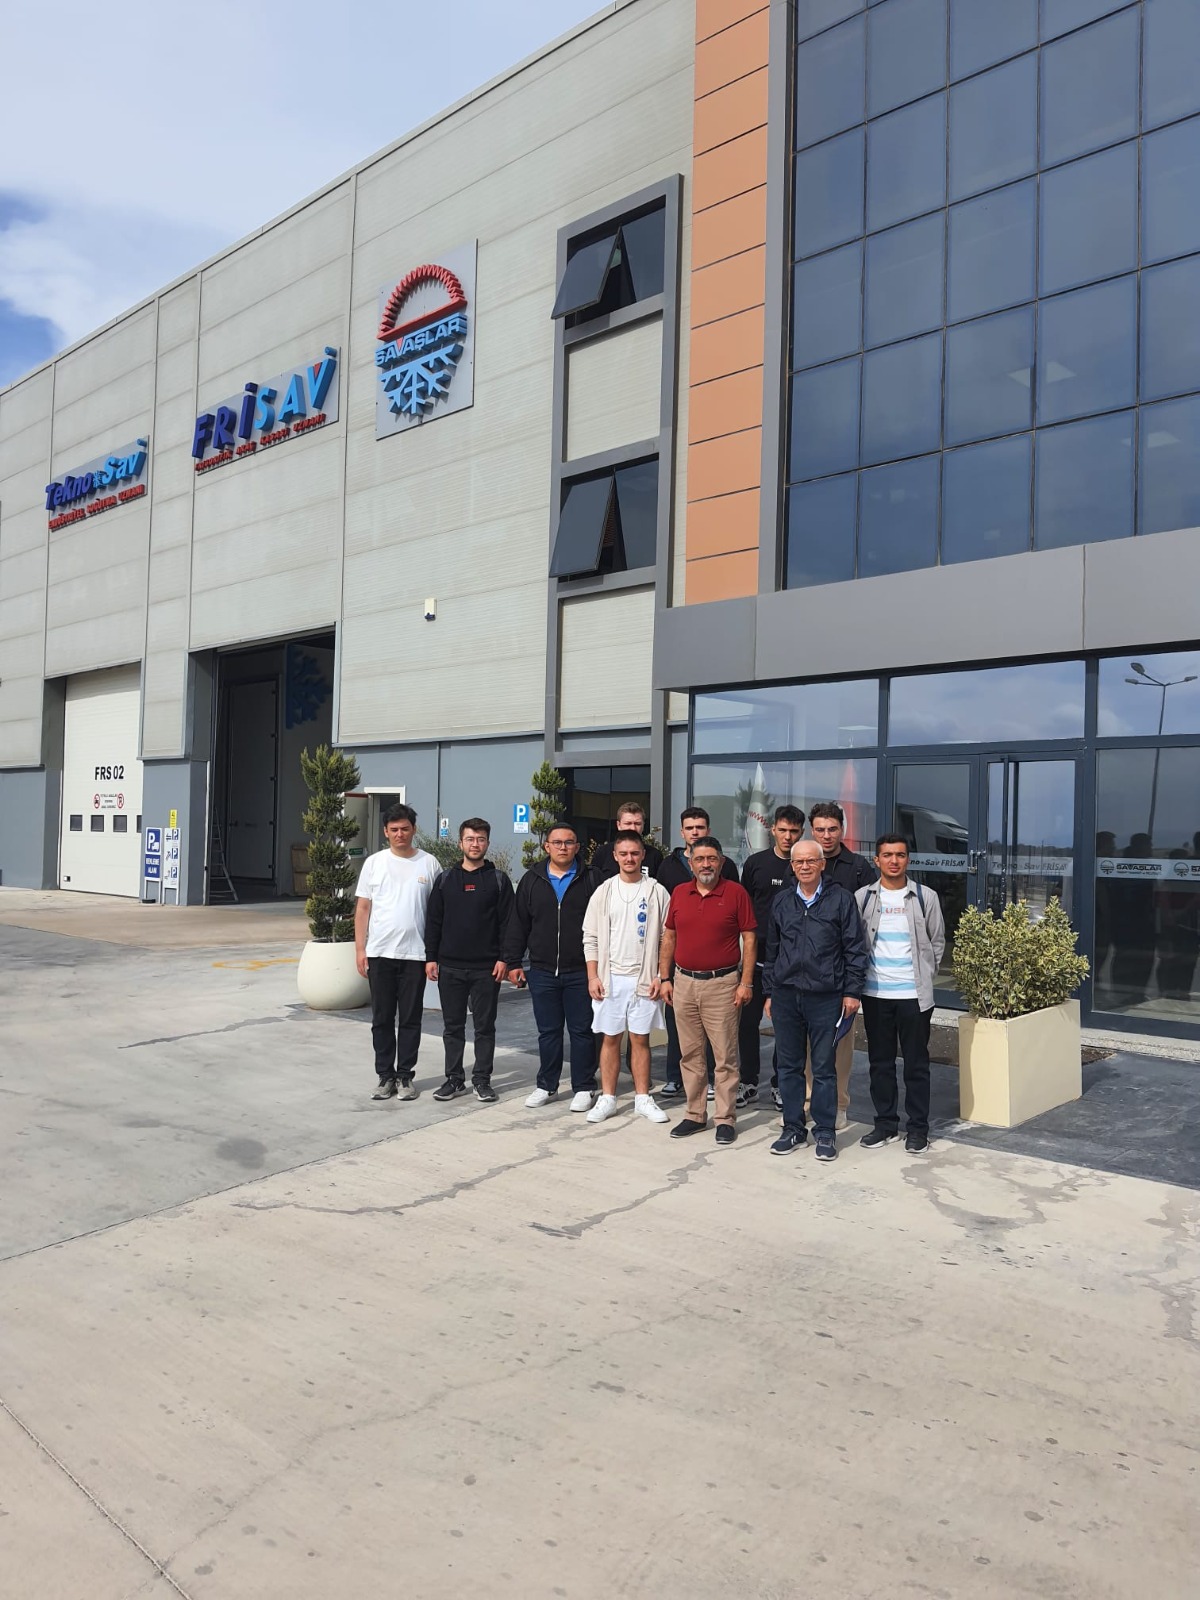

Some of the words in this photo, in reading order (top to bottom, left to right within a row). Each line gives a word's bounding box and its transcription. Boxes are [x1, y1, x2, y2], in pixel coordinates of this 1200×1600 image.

[375, 318, 467, 367] SAVAŞLAR
[192, 350, 337, 459] FRİSAV
[45, 472, 96, 511] Tekno
[95, 766, 112, 780] FRS
[113, 765, 124, 779] 02
[517, 805, 526, 822] P
[148, 832, 156, 849] P
